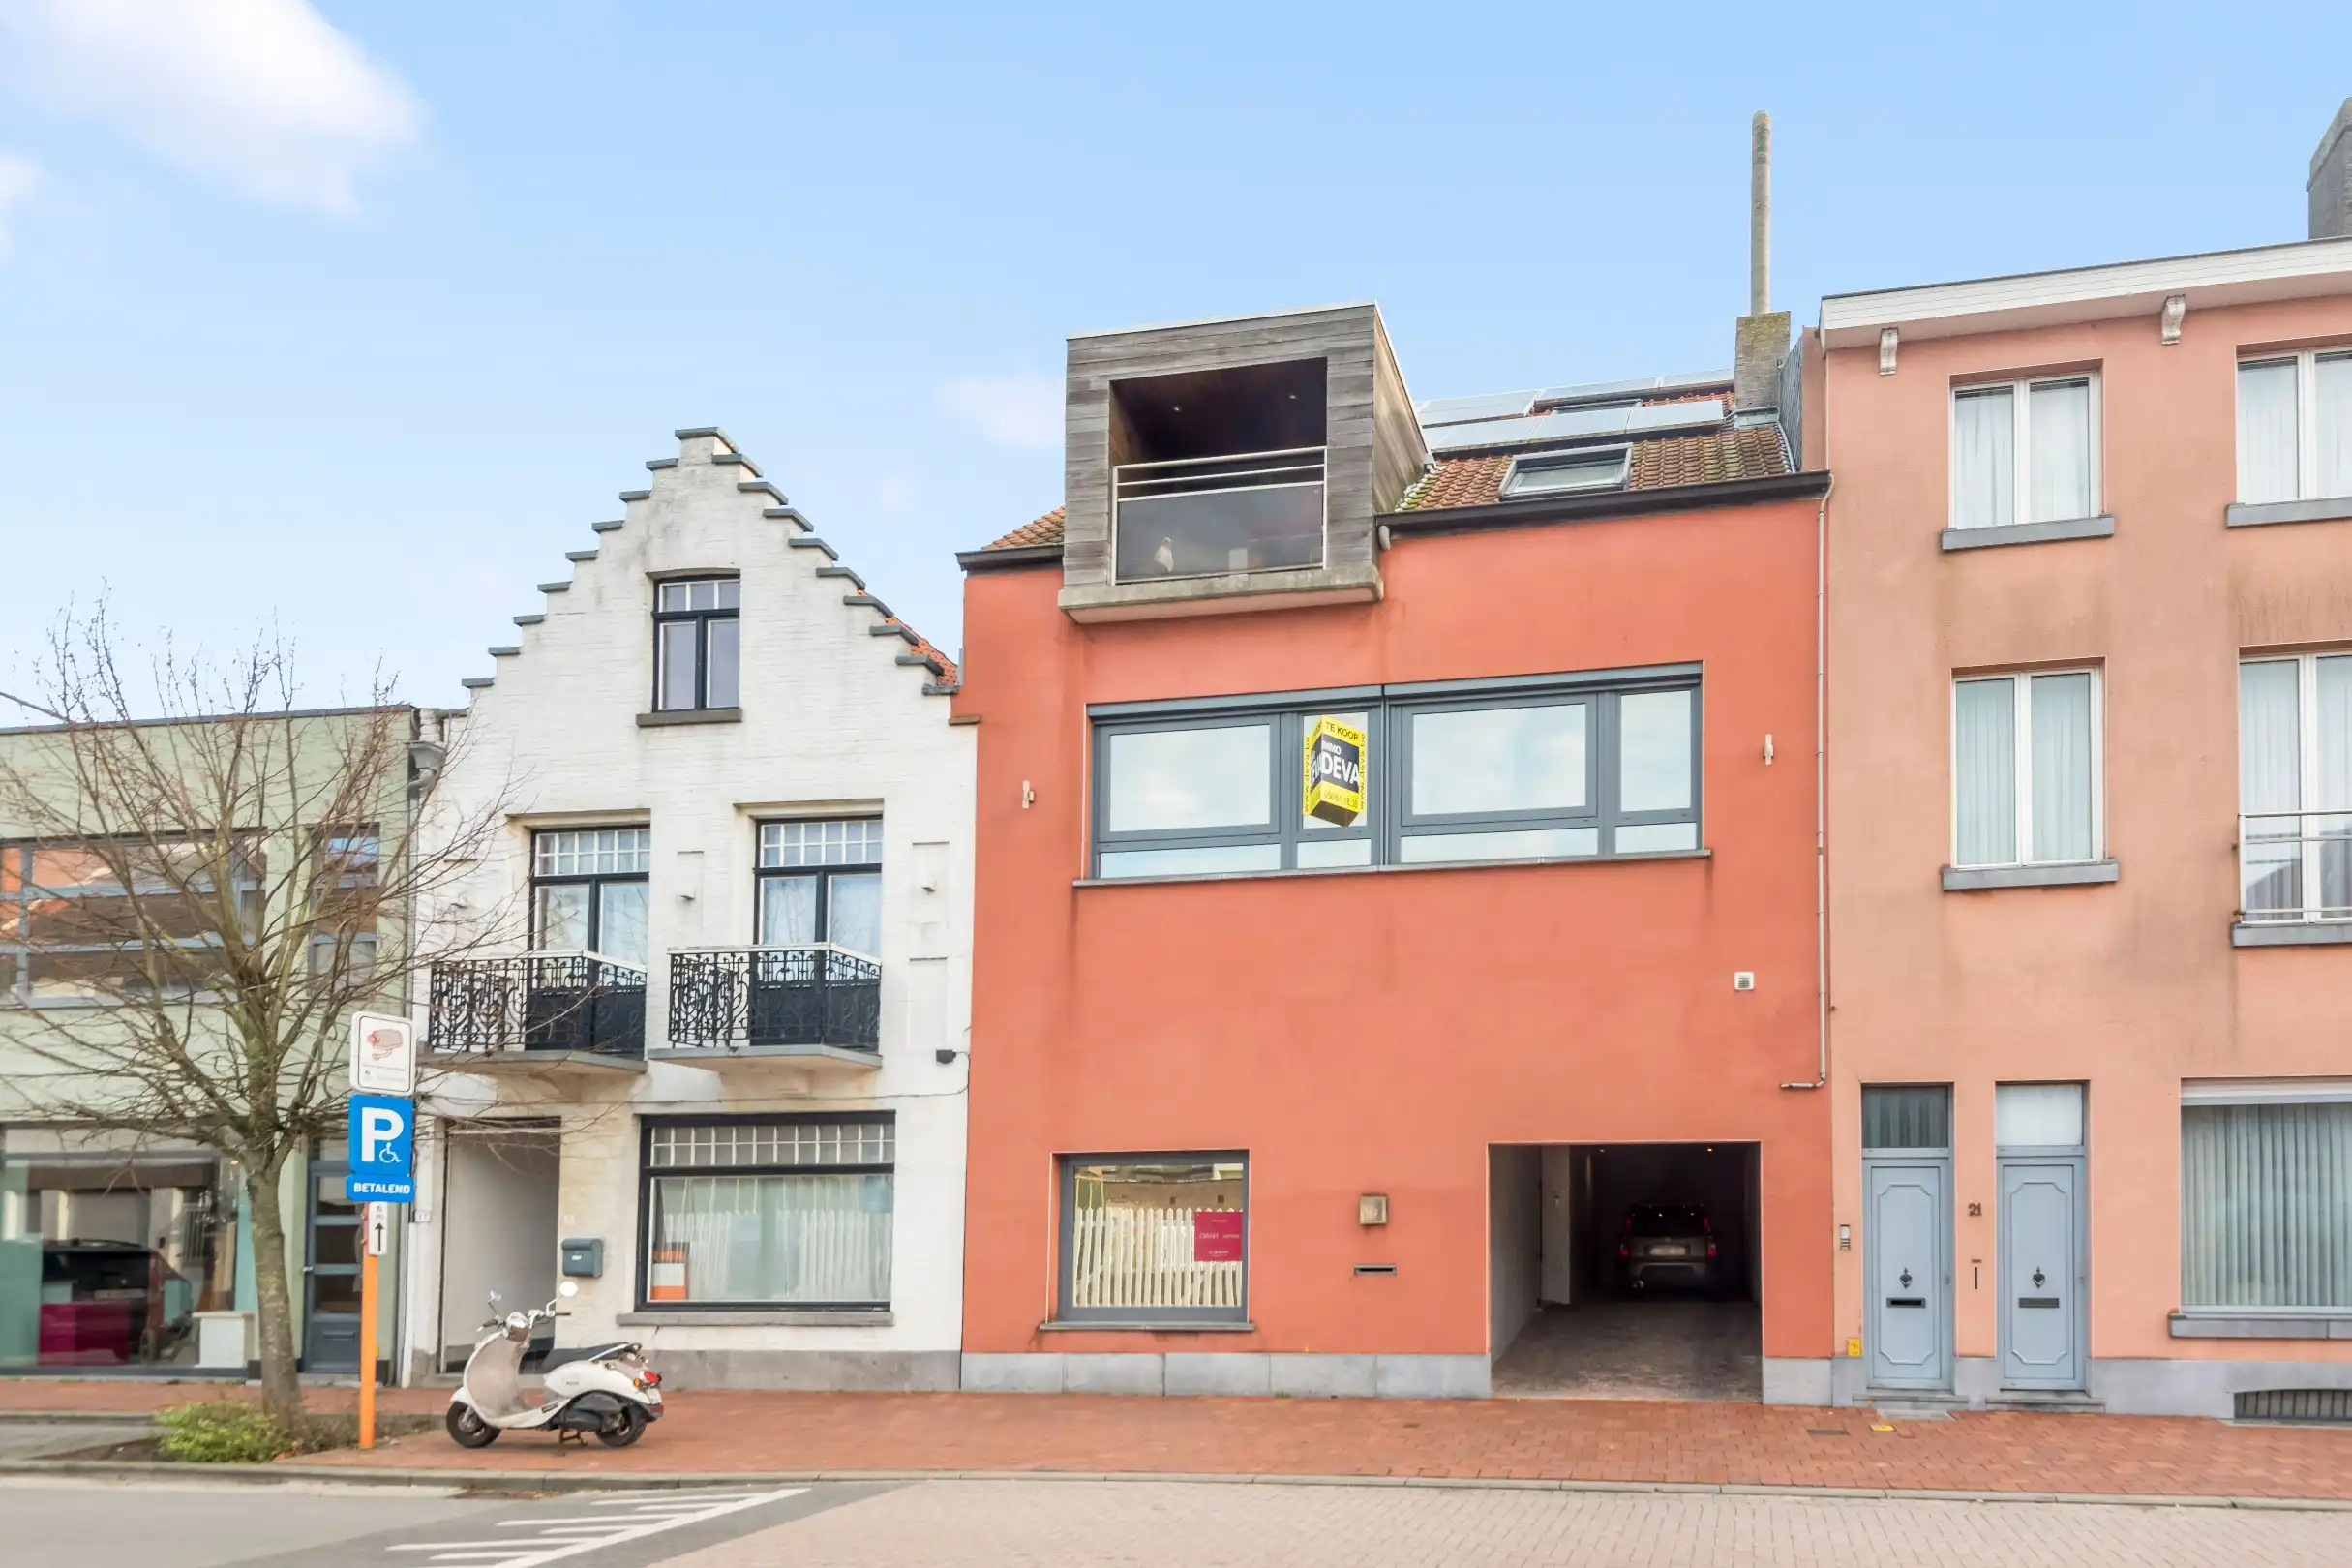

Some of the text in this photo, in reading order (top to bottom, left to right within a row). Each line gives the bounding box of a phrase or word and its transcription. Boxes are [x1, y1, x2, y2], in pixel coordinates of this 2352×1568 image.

[1326, 721, 1336, 732] TE
[1337, 725, 1359, 739] KOOP
[1322, 740, 1342, 755] IMMO
[1321, 750, 1359, 786] DEVA
[361, 1106, 405, 1162] P
[353, 1182, 411, 1194] BETALEND
[1968, 1203, 1982, 1217] 21
